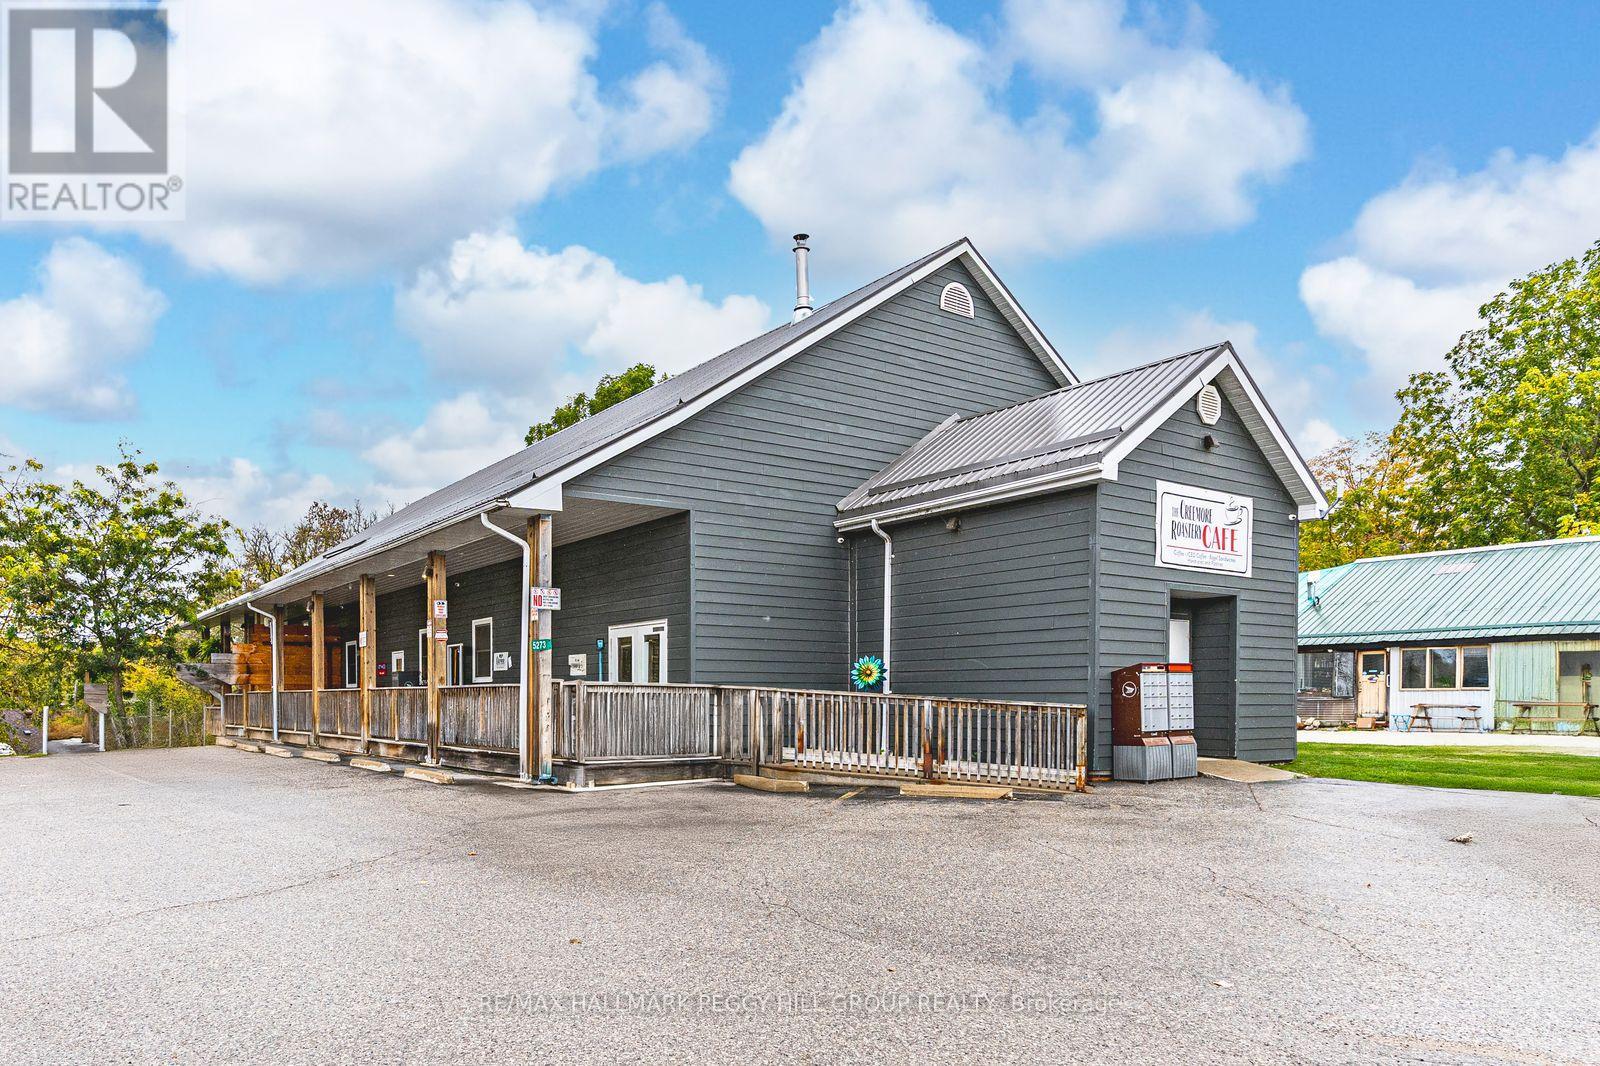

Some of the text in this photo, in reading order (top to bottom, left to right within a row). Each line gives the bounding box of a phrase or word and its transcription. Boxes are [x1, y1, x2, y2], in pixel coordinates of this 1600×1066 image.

[1180, 500, 1212, 524] CREEMORE
[1171, 520, 1238, 552] ROASTERY CAFE
[533, 595, 542, 606] NO
[533, 641, 546, 650] 5273
